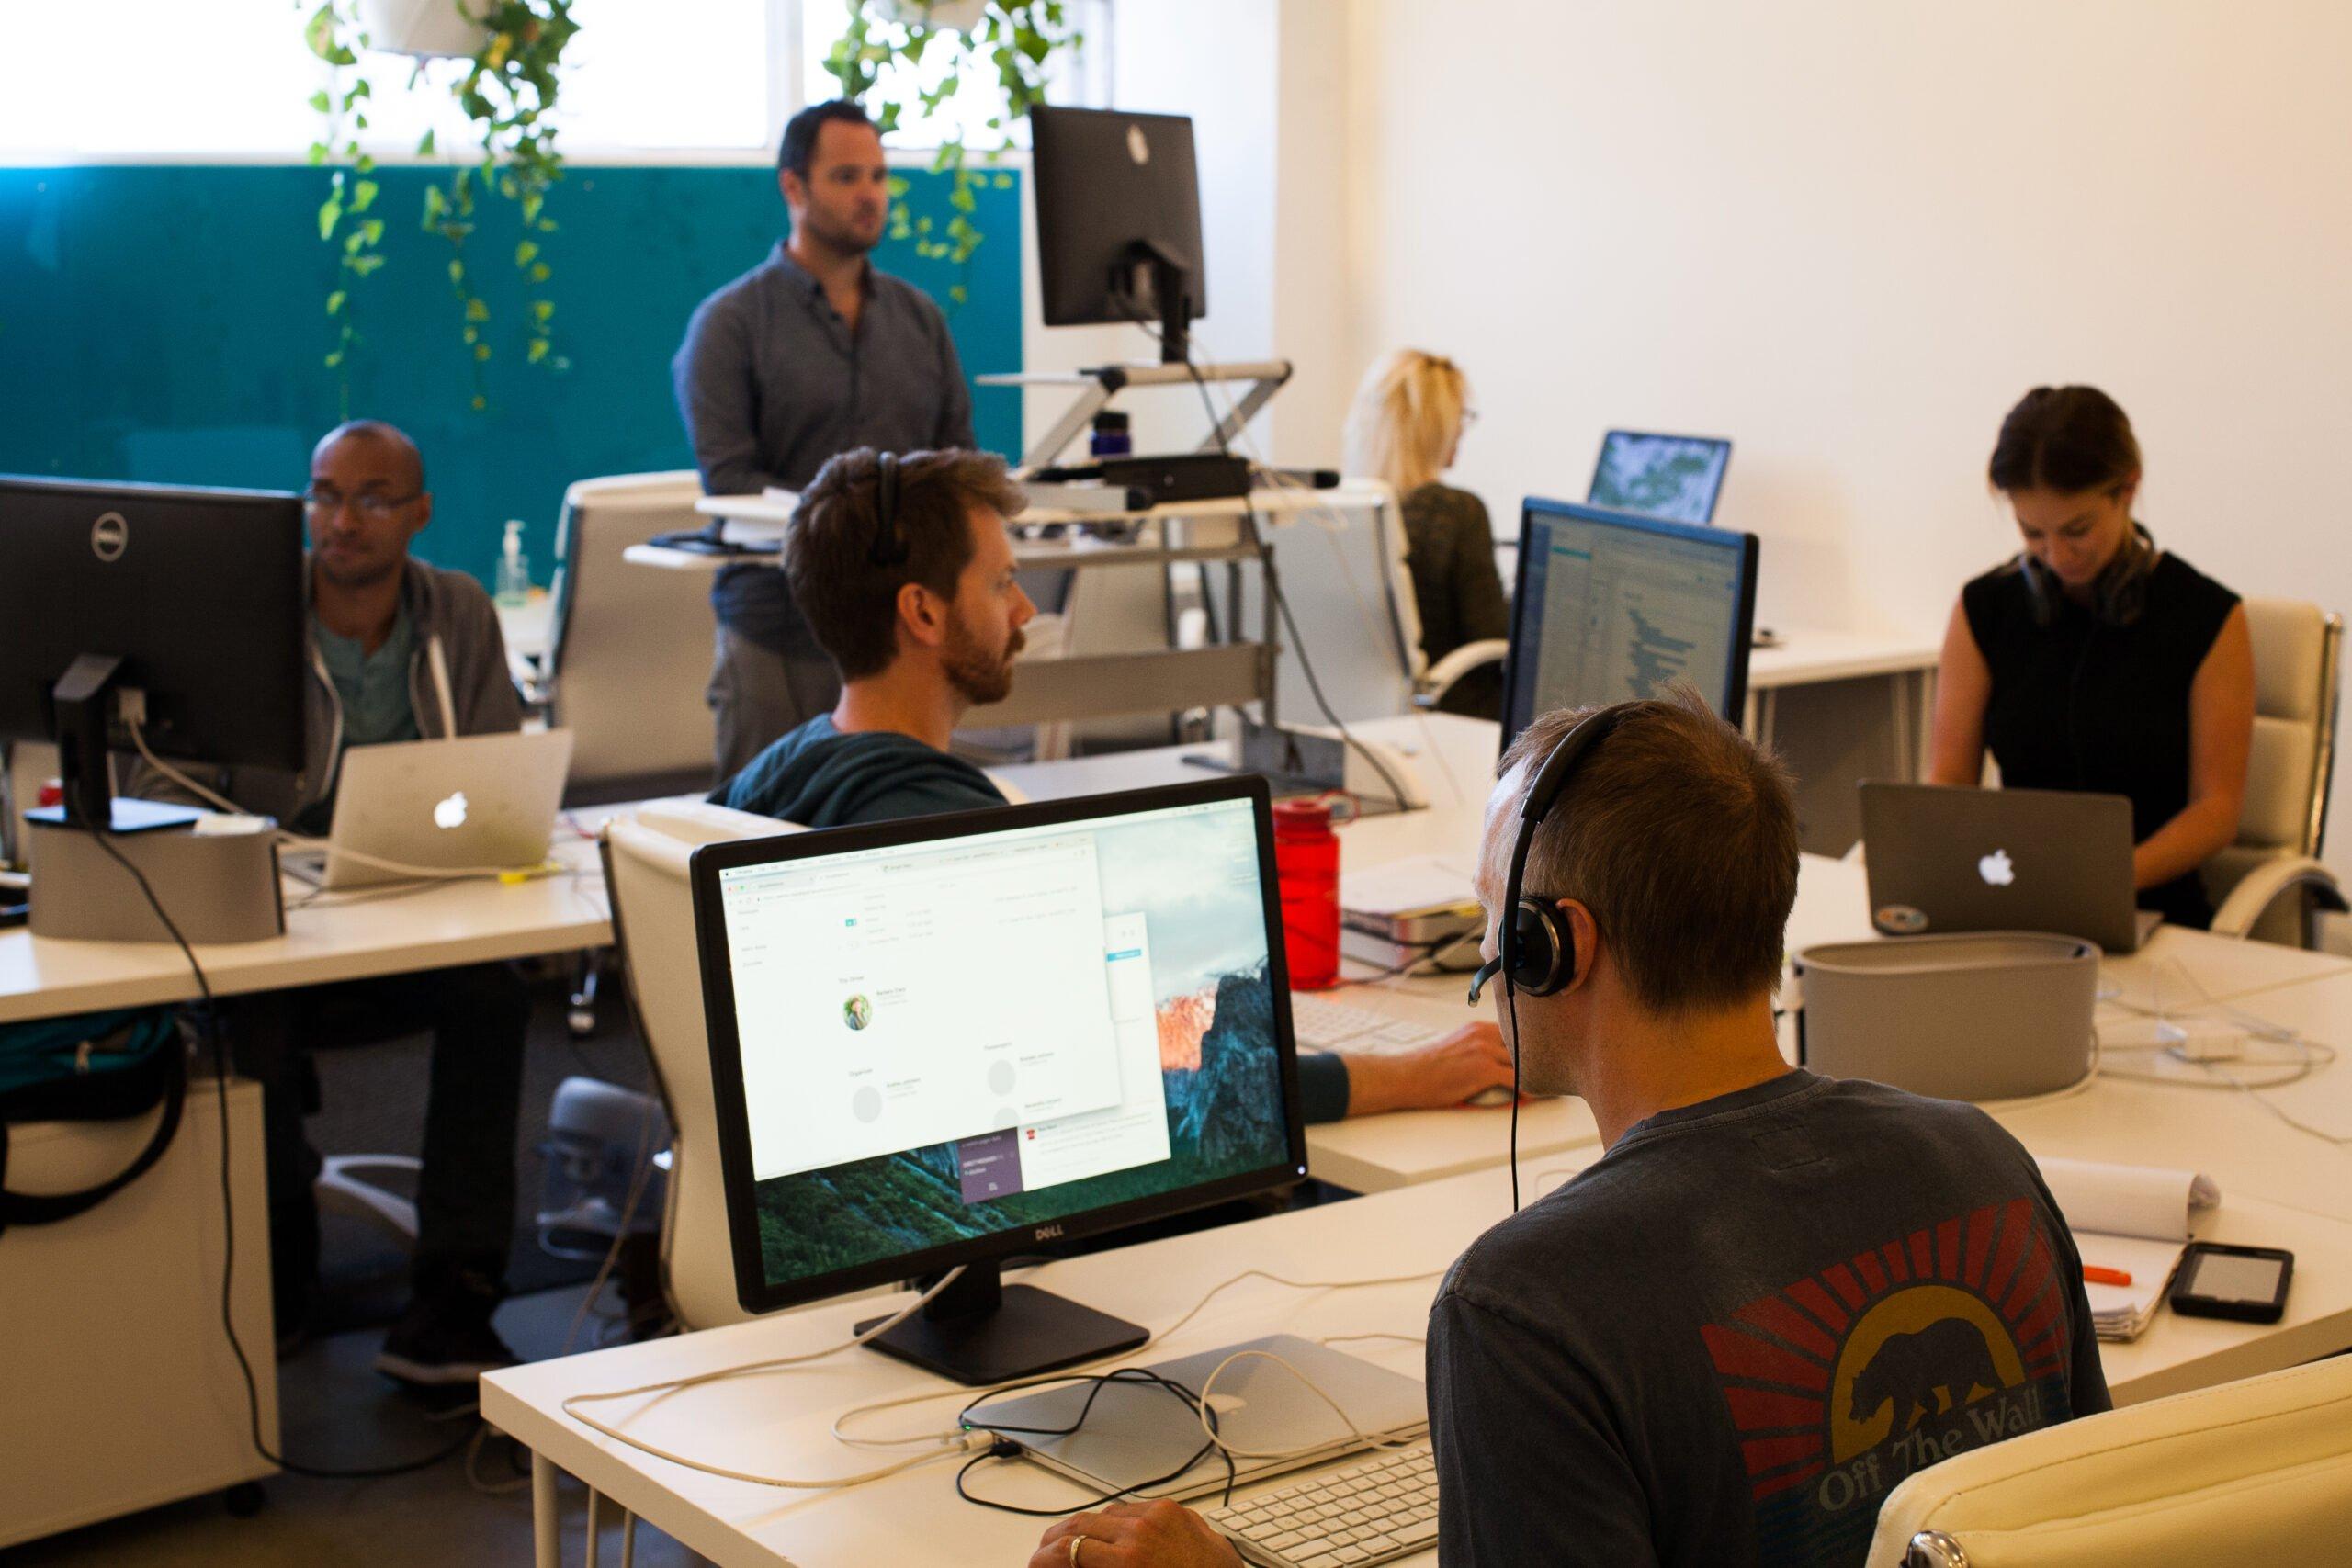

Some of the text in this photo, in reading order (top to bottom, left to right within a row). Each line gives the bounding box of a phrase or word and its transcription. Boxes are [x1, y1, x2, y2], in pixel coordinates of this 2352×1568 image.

[1035, 1224, 1064, 1240] DELL
[1818, 1384, 2043, 1512] Off The Wall
